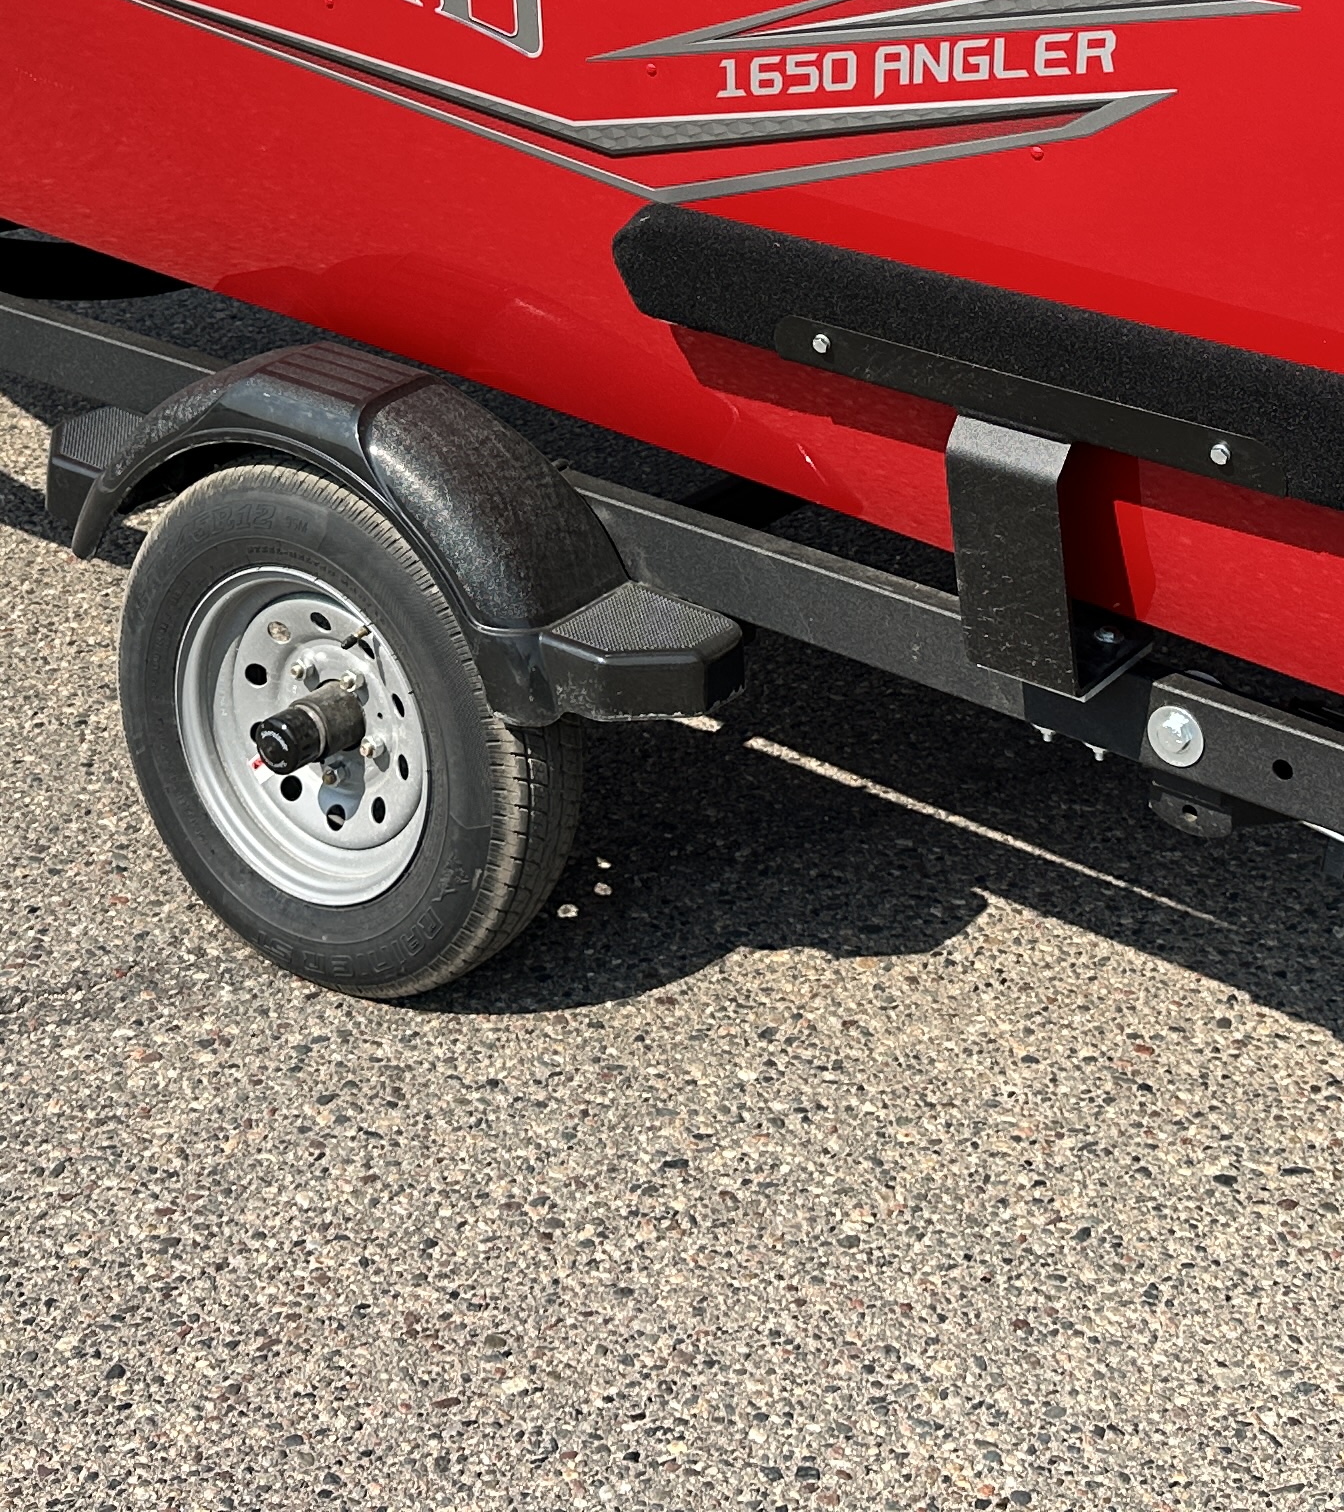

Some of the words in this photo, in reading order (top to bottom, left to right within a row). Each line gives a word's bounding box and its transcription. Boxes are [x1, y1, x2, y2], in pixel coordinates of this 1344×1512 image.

[716, 50, 857, 99] 1650
[874, 29, 1117, 99] ANGLER
[302, 905, 444, 979] RAINIER
